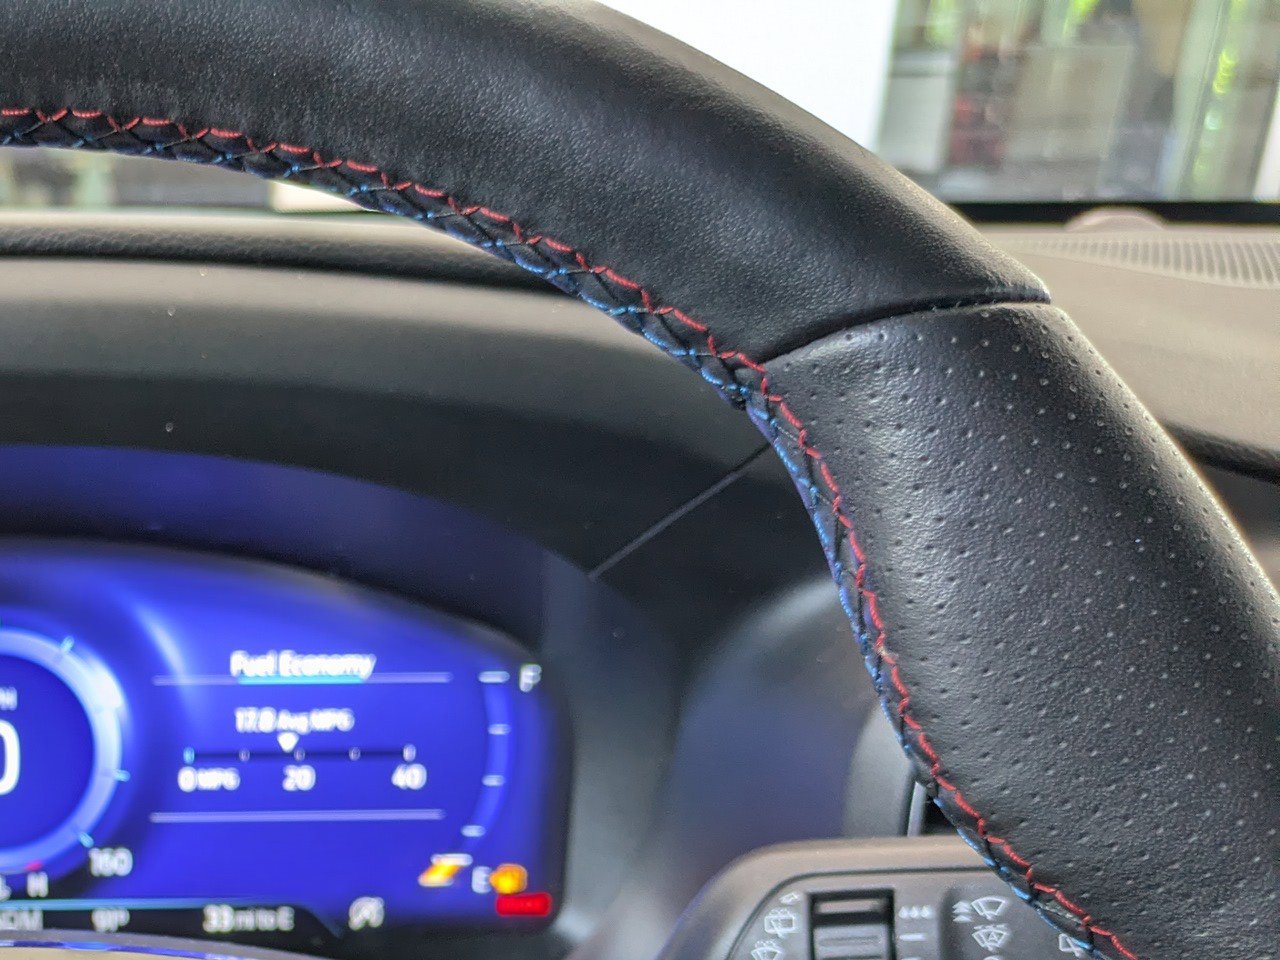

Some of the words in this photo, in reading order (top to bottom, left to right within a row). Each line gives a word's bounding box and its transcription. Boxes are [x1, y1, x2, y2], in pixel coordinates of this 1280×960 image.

[230, 650, 277, 676] Fuel
[278, 650, 377, 680] Economy
[308, 708, 355, 732] MPG
[282, 764, 316, 792] 20
[391, 763, 428, 790] 40
[88, 847, 134, 877] 160
[25, 871, 49, 898] H
